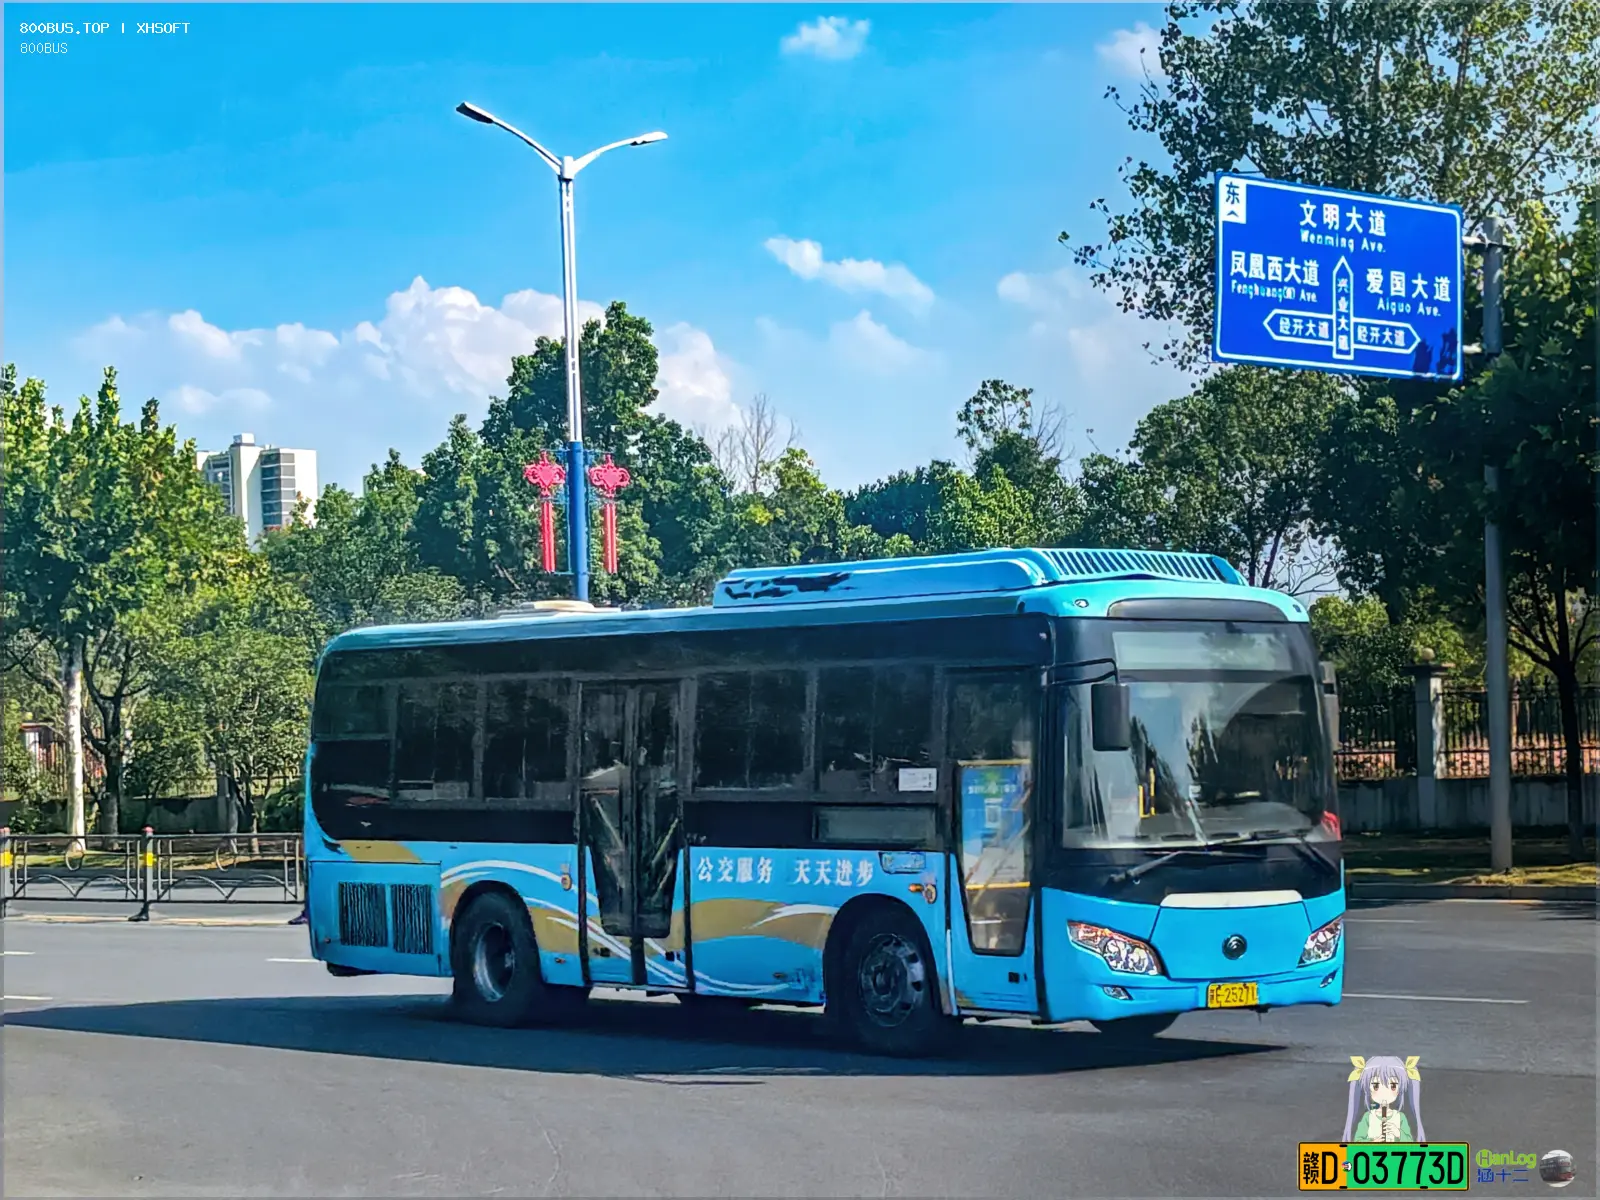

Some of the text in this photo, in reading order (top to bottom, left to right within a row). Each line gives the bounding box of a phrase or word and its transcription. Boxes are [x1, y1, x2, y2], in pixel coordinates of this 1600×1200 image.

[1225, 181, 1240, 205] 东
[1300, 200, 1386, 237] 文明大道
[1300, 229, 1386, 253] Wenming Ave.
[1230, 251, 1320, 287] 凤凰西大道
[1366, 267, 1451, 302] 爱国大道
[1337, 278, 1350, 350] 兴业大道
[1377, 297, 1441, 317] Aiguo Ave.
[1279, 316, 1330, 340] 经开大道
[1357, 325, 1406, 348] 经开大道
[698, 856, 873, 887] 公交服务 天天进步
